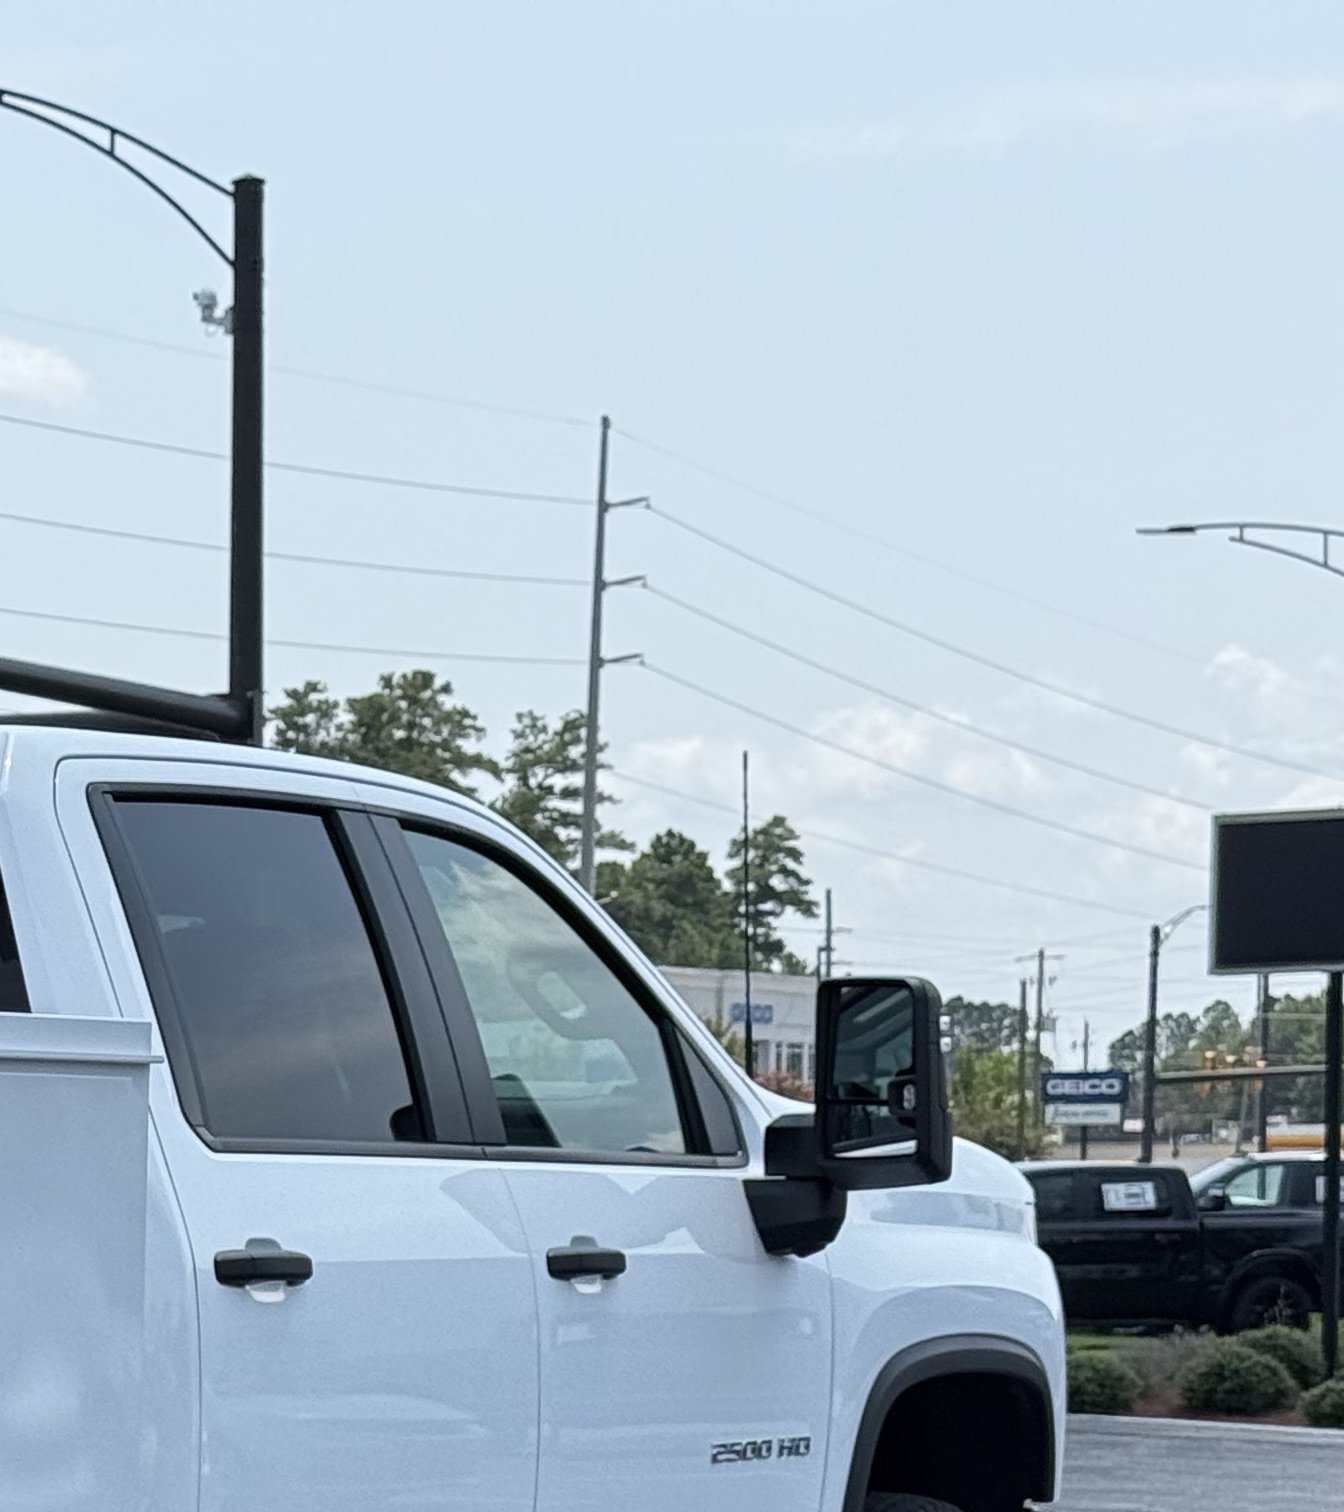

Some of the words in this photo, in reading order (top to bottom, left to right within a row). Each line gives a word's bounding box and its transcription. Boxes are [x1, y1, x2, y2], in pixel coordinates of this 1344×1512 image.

[1046, 1078, 1121, 1096] GEICO
[711, 1441, 772, 1464] 2500
[777, 1437, 811, 1459] HD
